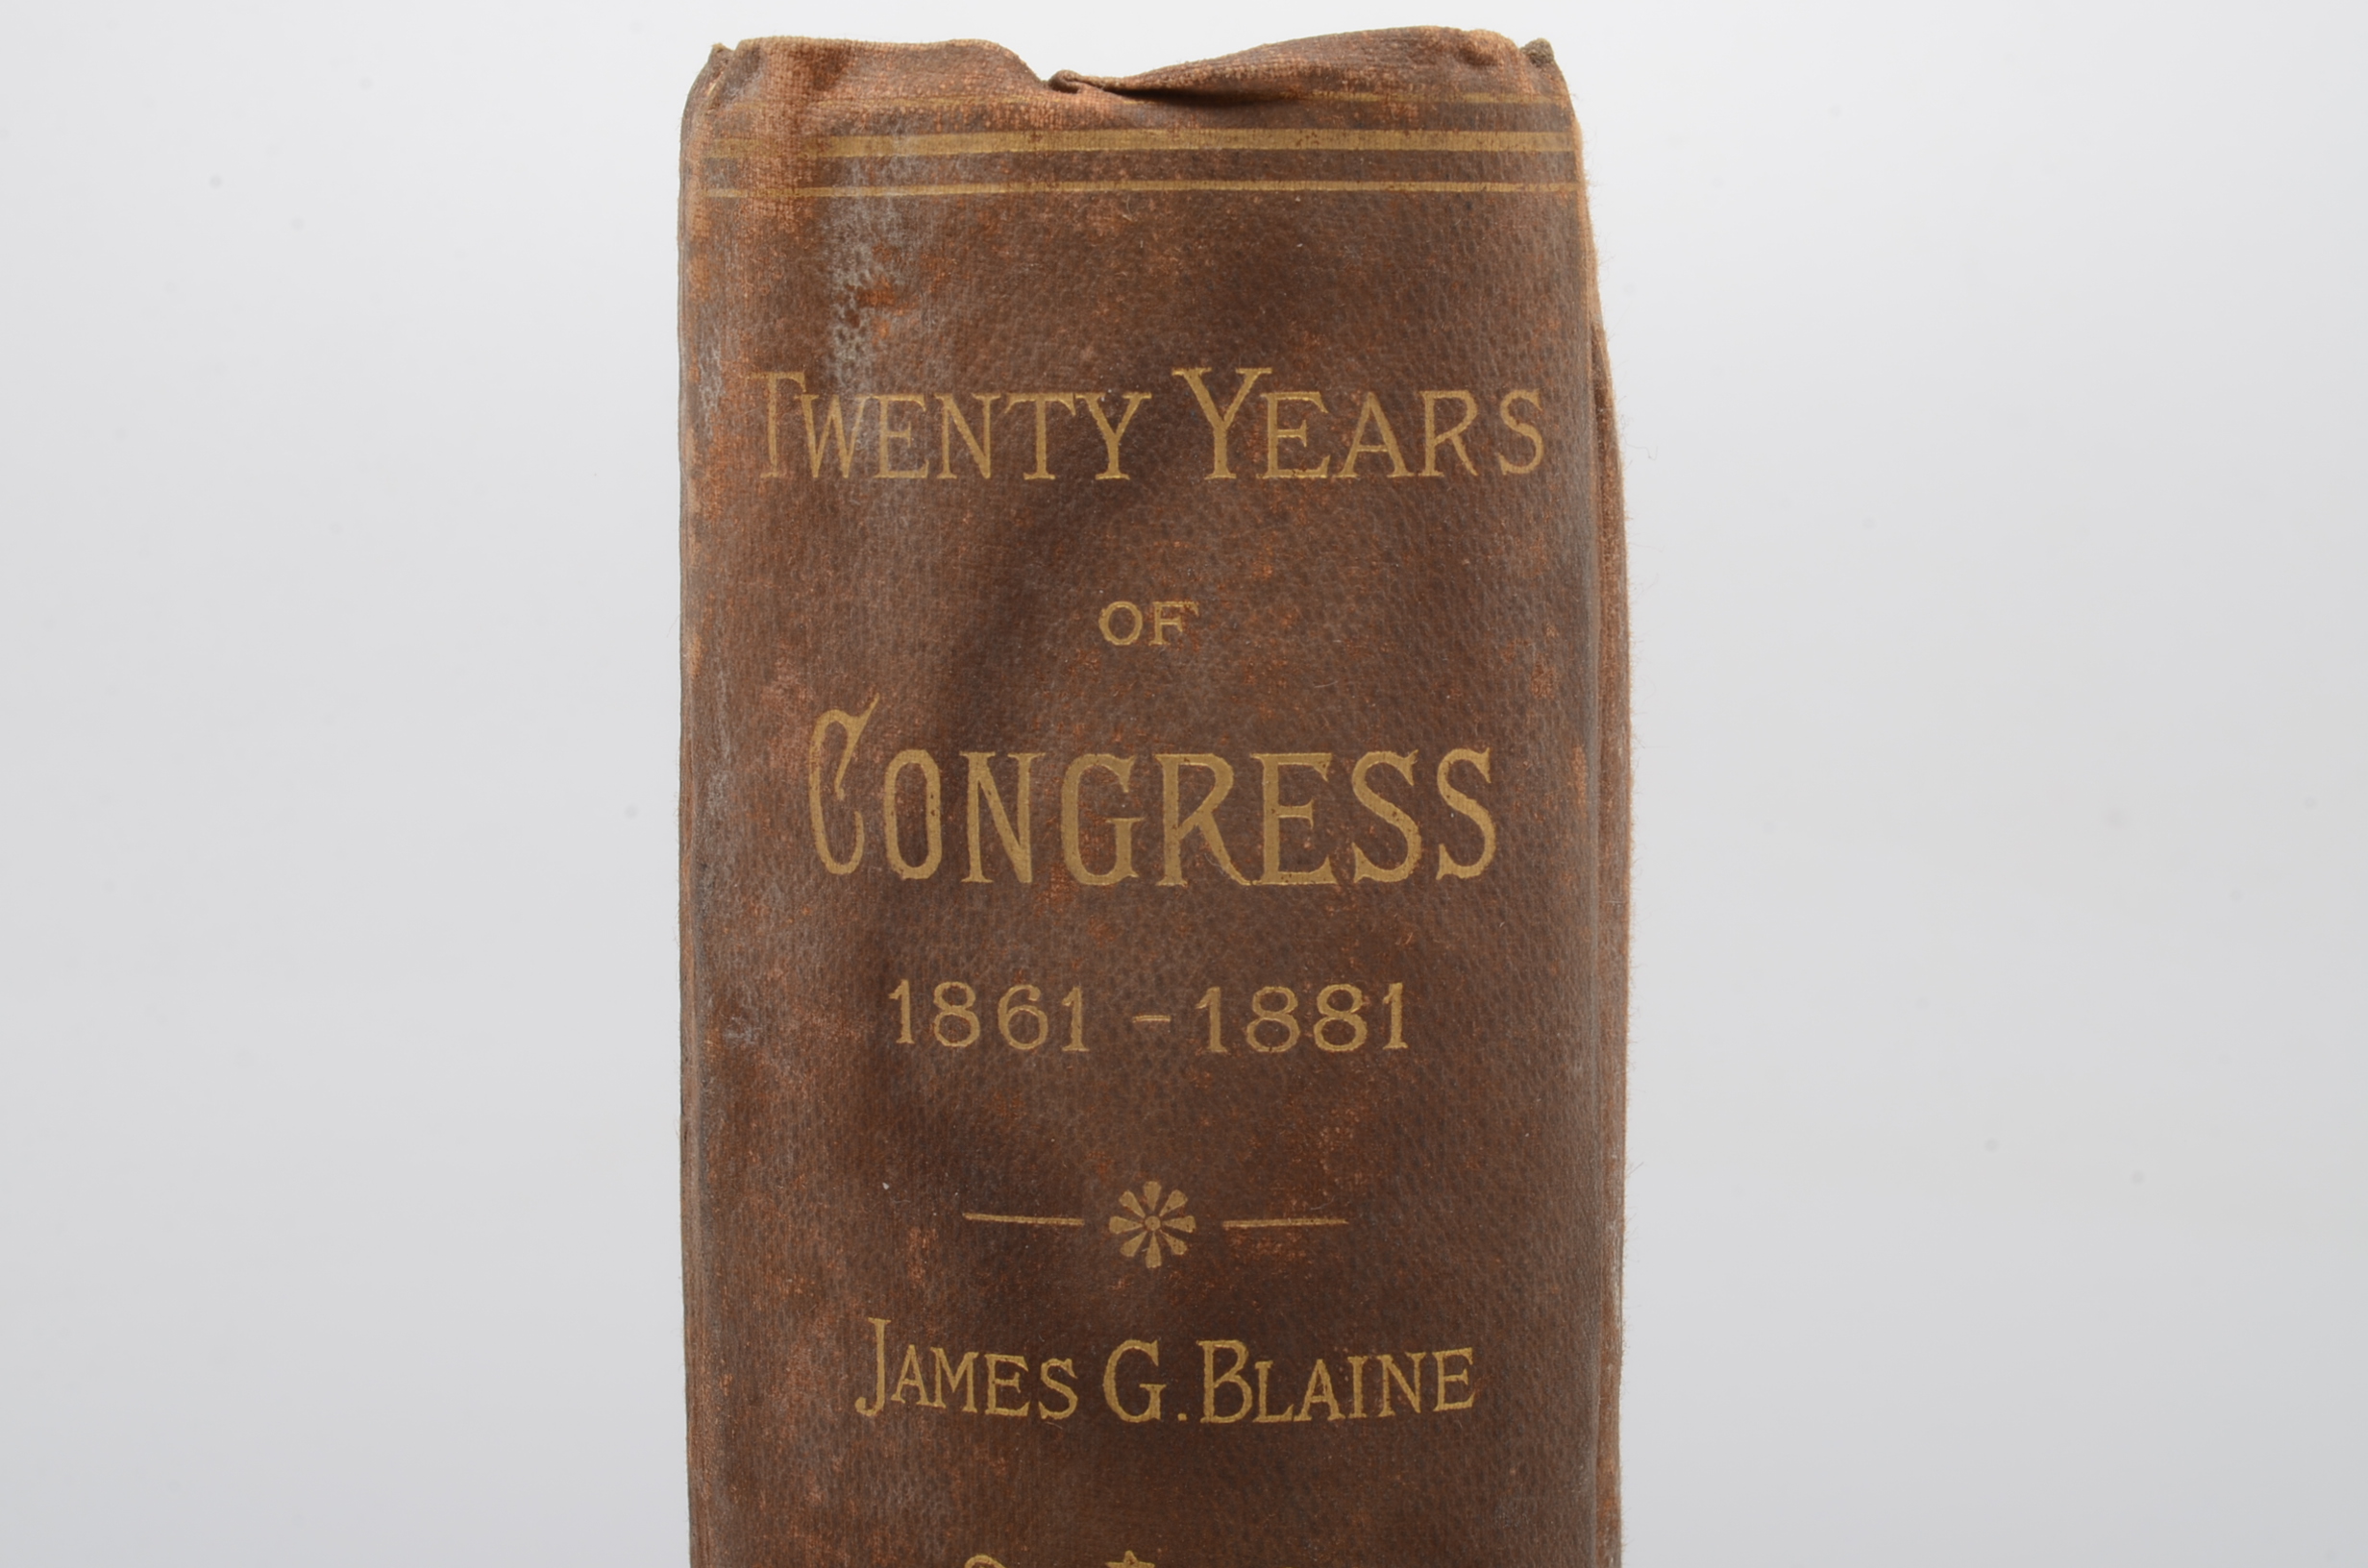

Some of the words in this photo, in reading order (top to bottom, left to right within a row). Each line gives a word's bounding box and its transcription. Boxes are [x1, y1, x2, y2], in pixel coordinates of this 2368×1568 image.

[750, 369, 1152, 482] TWENTY
[1172, 366, 1545, 481] YEARS
[1098, 600, 1199, 647] OF
[808, 695, 1498, 888] CONGRESS
[888, 978, 1090, 1053] 1861
[1196, 981, 1409, 1054] 1881
[854, 1317, 1079, 1421] JAMES
[1197, 1338, 1477, 1424] BLAINE
